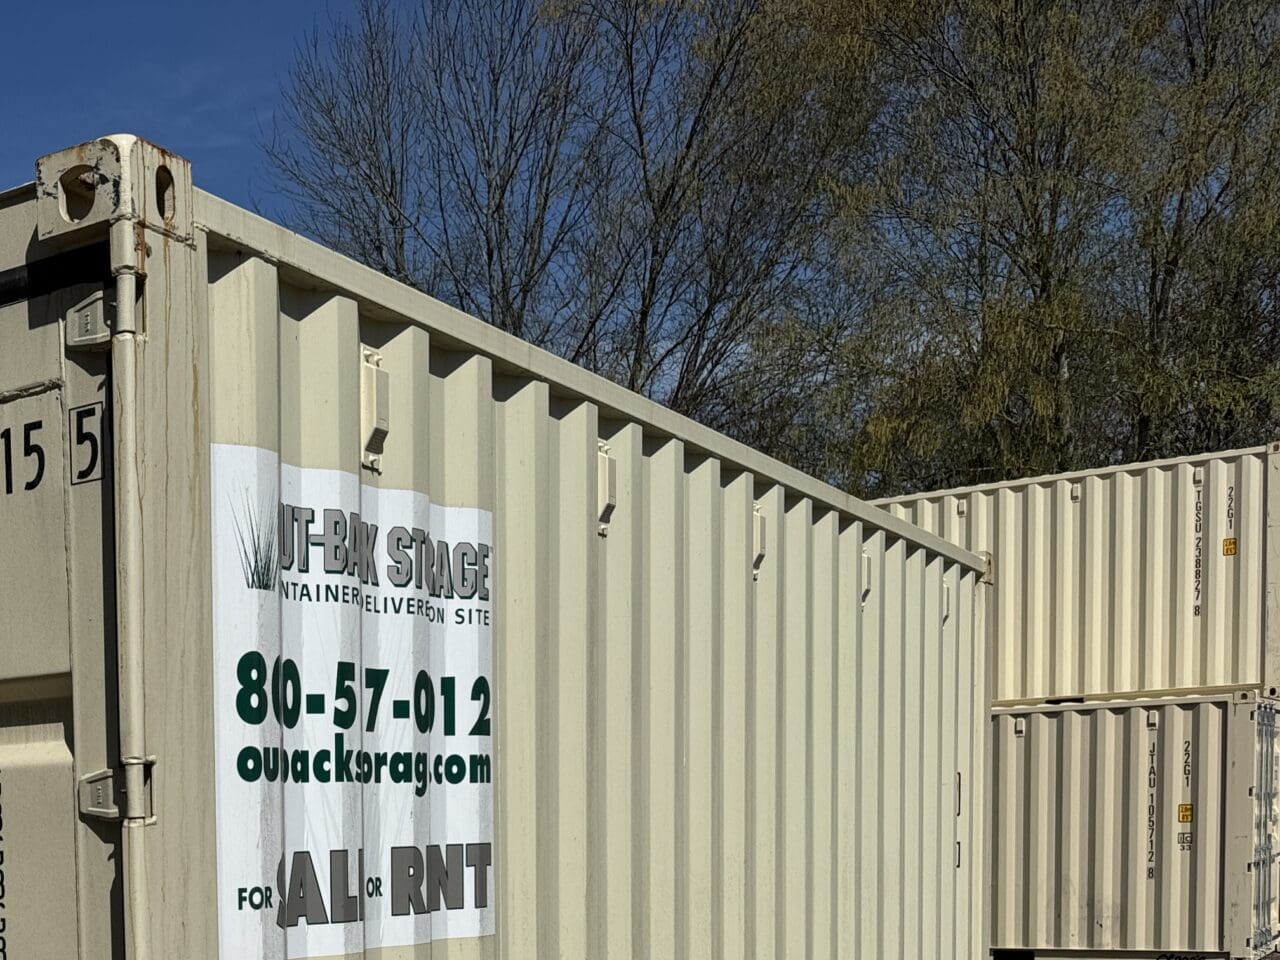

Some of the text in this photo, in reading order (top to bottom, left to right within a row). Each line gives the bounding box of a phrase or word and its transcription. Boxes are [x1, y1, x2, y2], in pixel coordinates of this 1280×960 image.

[76, 407, 99, 480] 5
[455, 608, 490, 626] SITE
[1183, 740, 1191, 788] 22G1
[238, 886, 273, 911] FOR
[366, 876, 383, 898] OR
